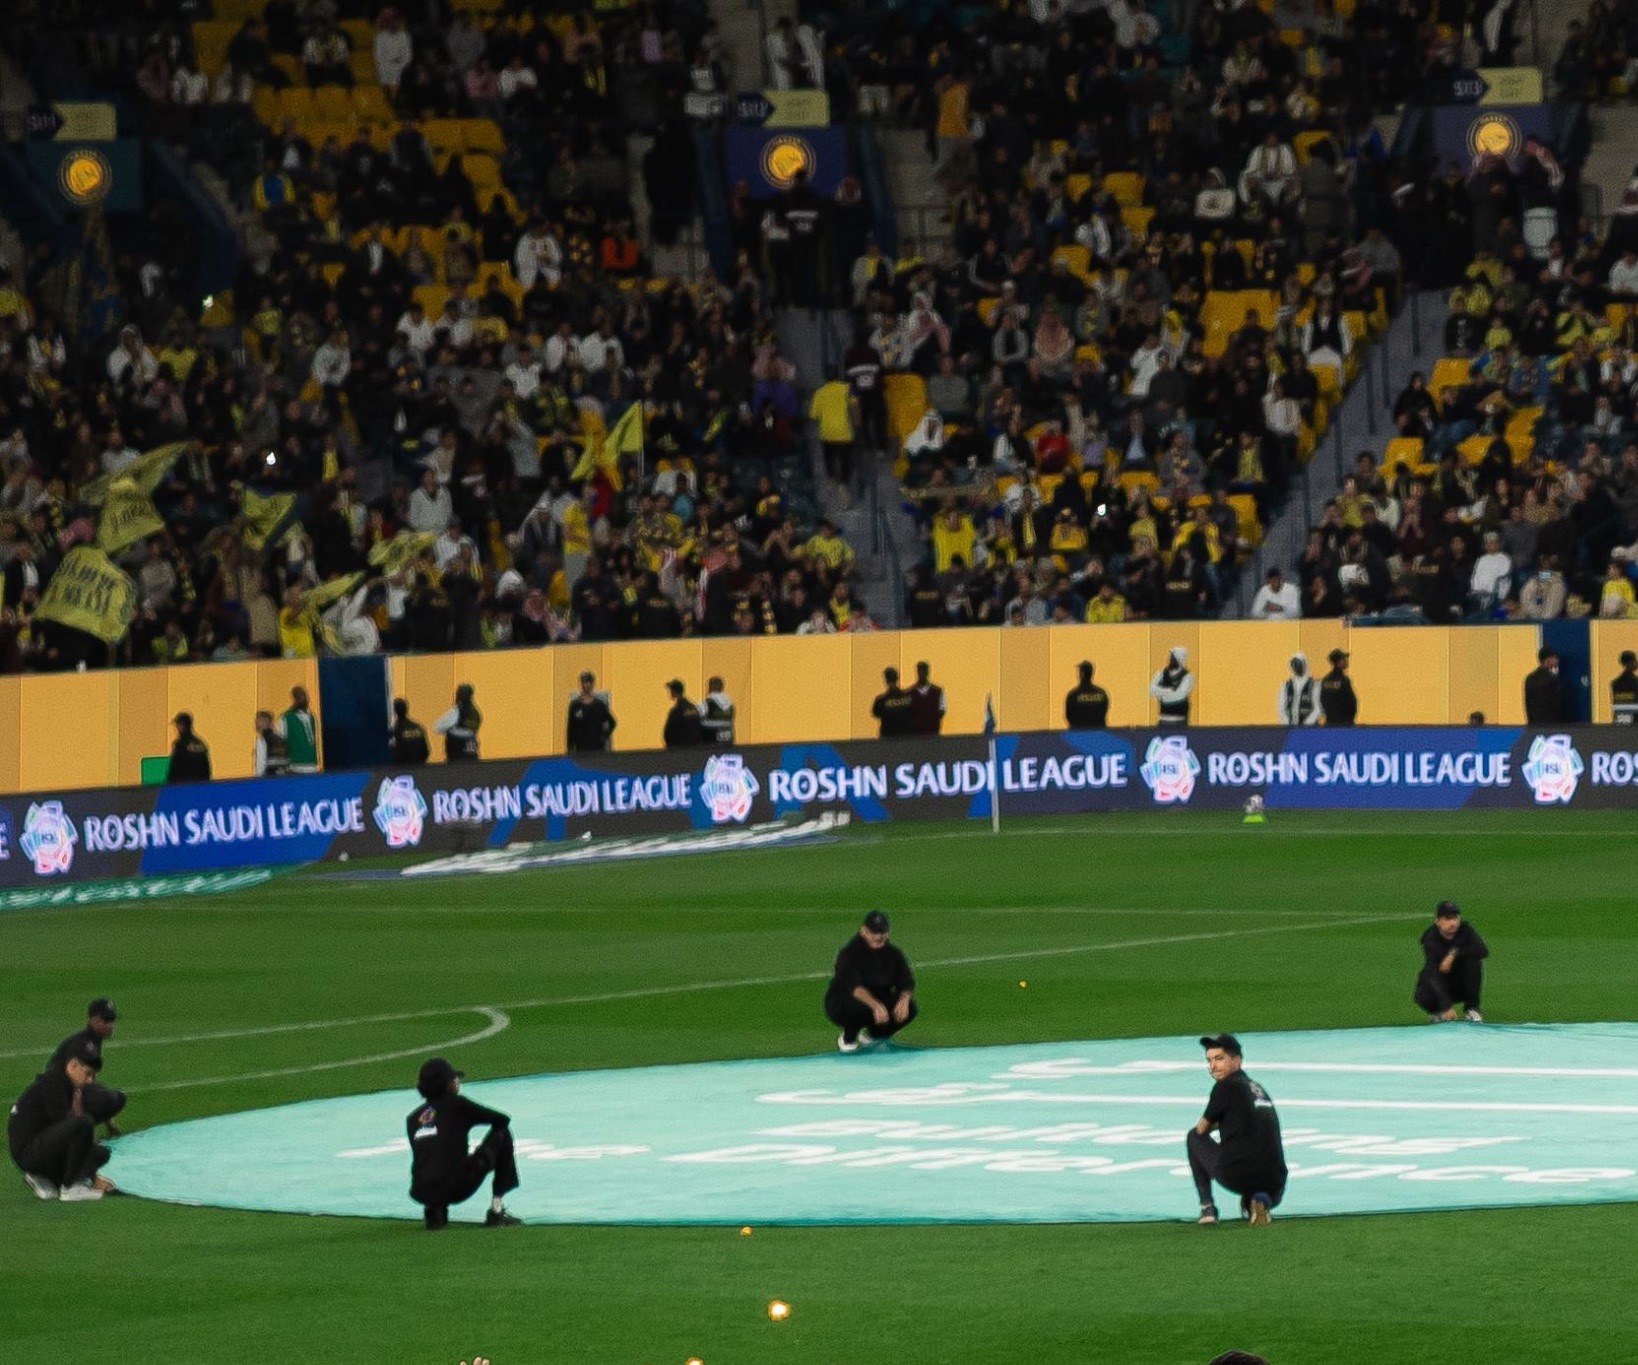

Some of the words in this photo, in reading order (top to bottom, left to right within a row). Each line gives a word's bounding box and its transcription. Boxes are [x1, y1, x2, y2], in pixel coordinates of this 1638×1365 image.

[769, 765, 887, 801] ROSHN
[895, 760, 994, 796] SAUDI
[1003, 754, 1127, 790] LEAGUE
[1208, 752, 1308, 785] ROSHN
[1315, 752, 1398, 785] SAUDI
[1405, 752, 1511, 785] LEAGUE
[659, 1143, 1636, 1184] Differnce
